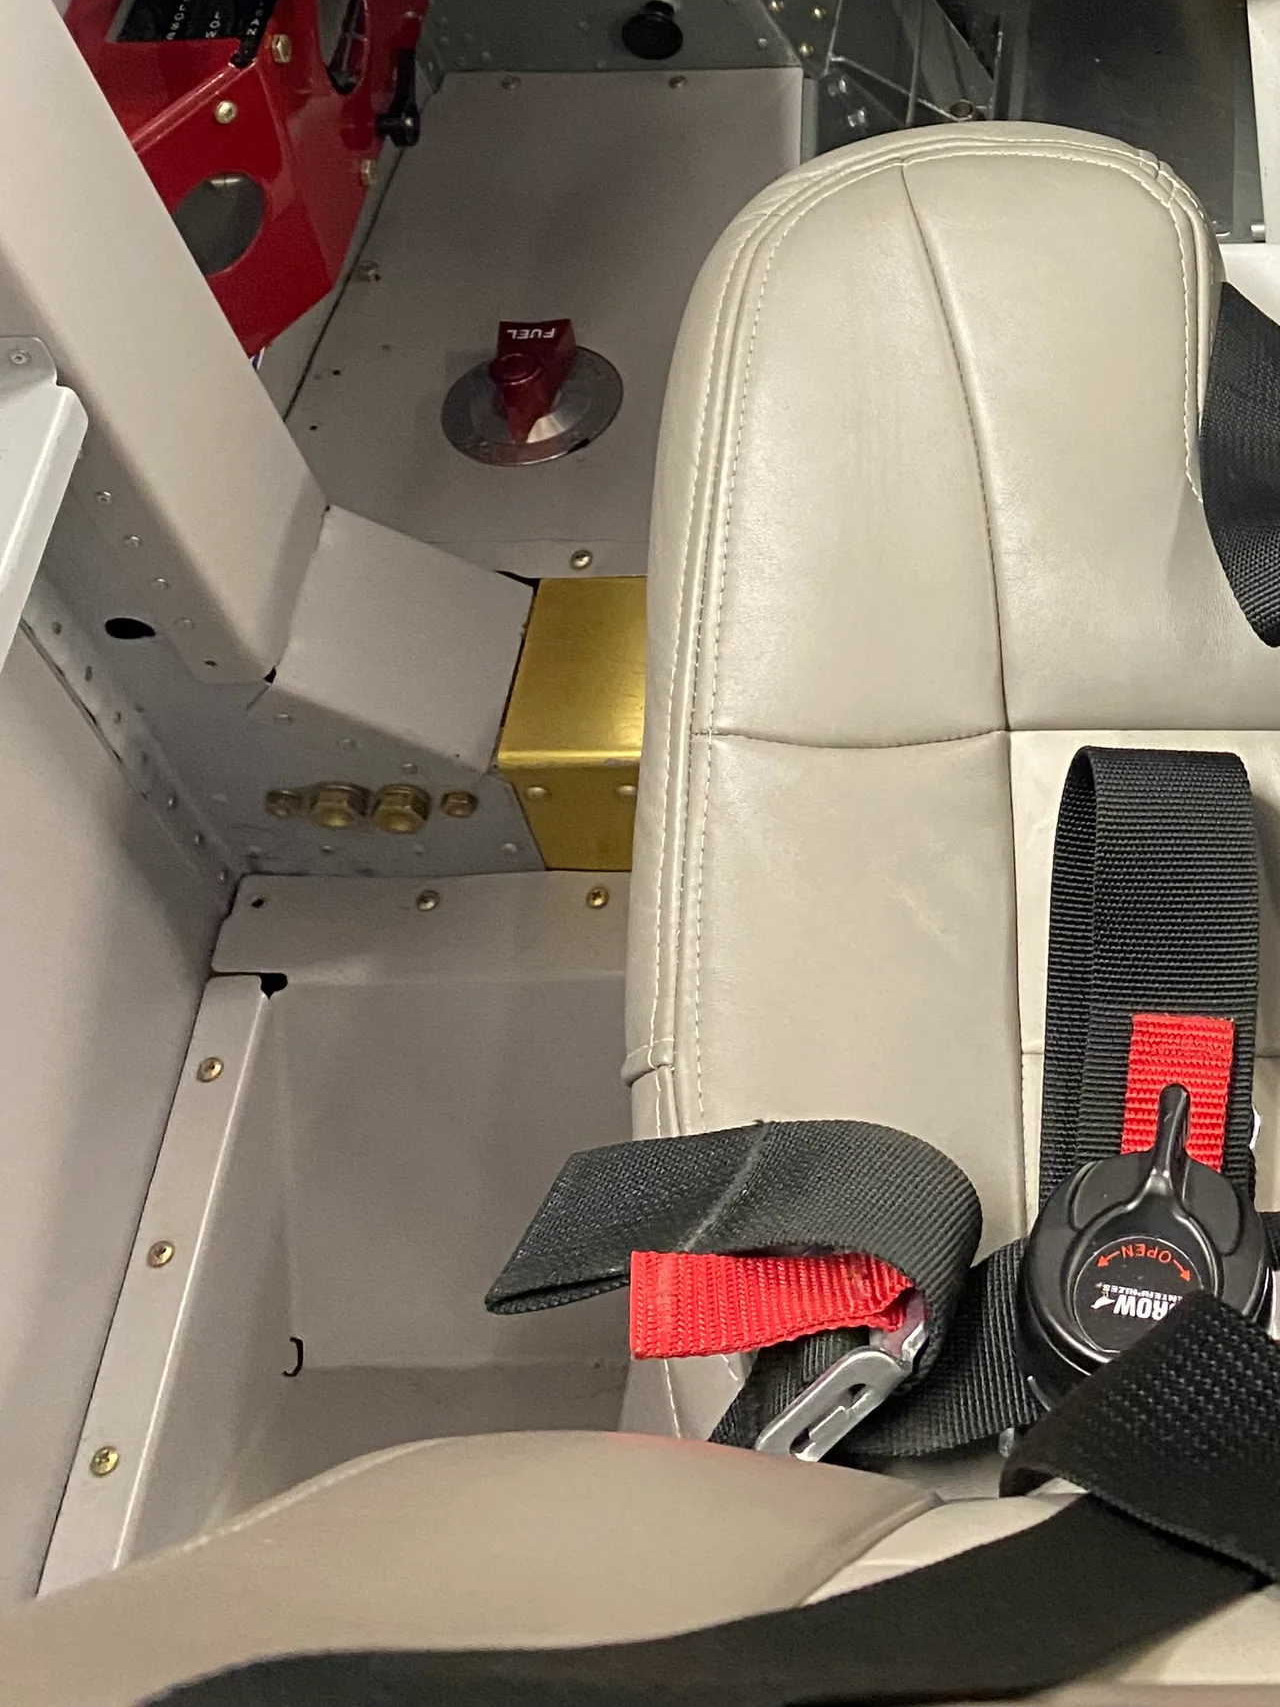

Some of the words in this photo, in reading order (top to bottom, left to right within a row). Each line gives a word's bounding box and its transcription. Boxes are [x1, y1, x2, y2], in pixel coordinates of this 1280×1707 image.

[507, 328, 555, 339] FUEL
[1121, 1244, 1172, 1263] OPEN
[1113, 1294, 1176, 1321] ROW
